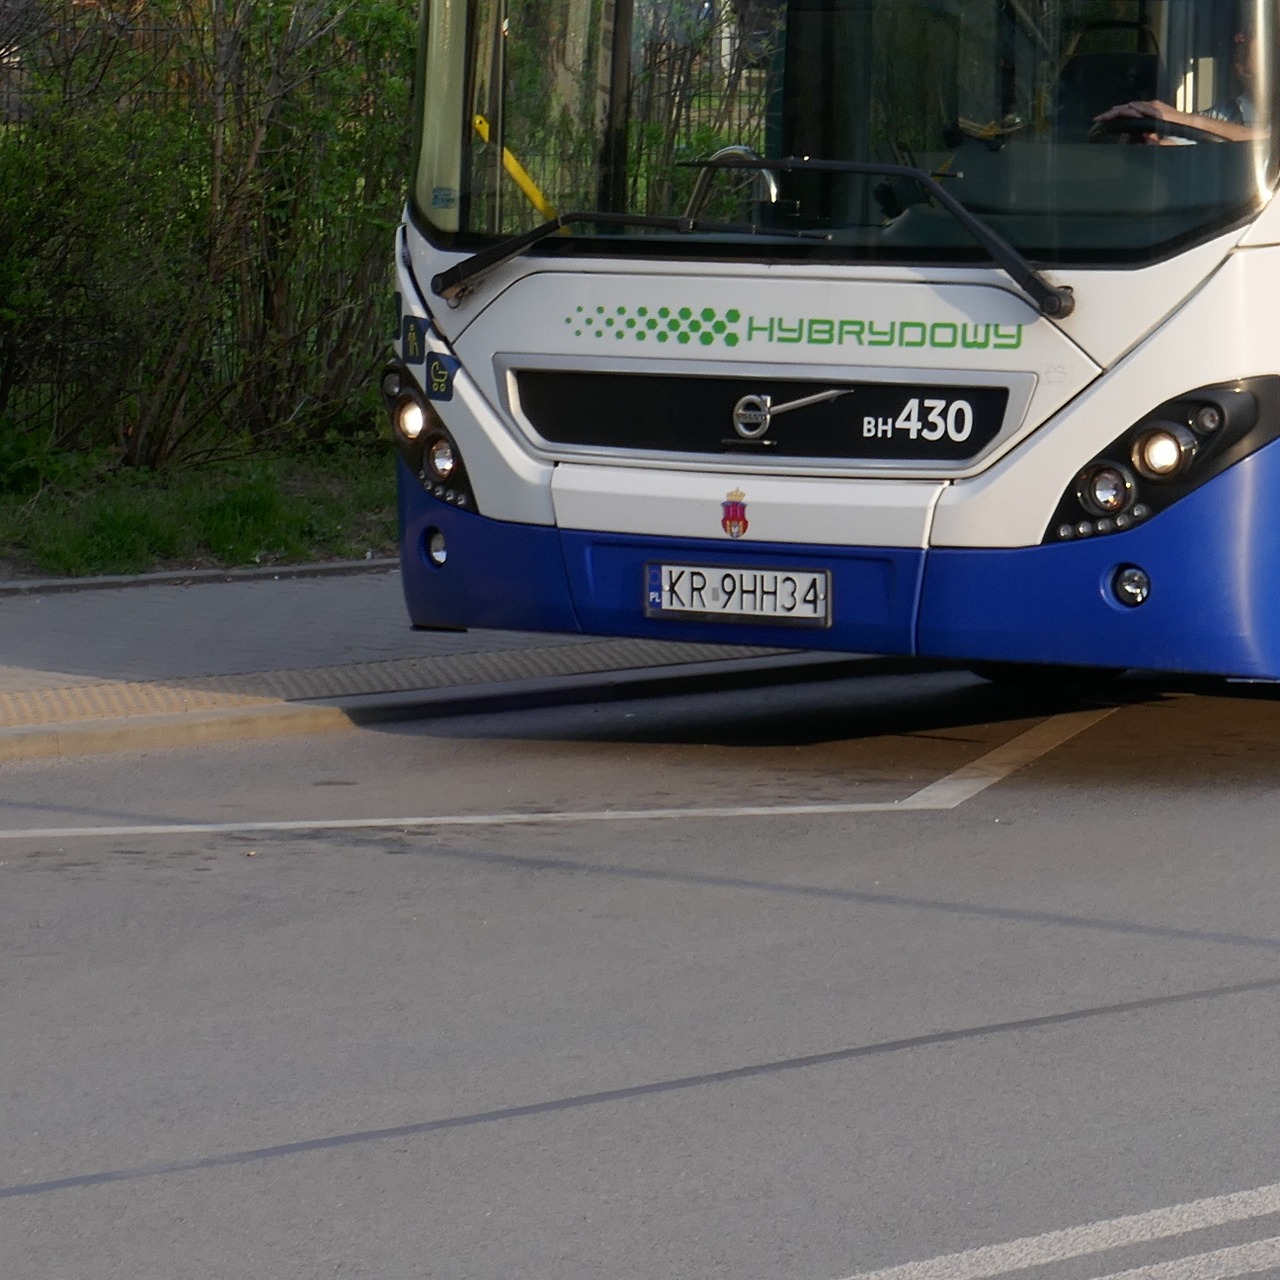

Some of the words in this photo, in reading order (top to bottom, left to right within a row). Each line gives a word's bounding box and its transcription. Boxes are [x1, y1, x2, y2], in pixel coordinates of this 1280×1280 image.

[746, 316, 1023, 350] HYBRYDOWY
[862, 398, 974, 442] BH430
[649, 591, 661, 603] PL
[668, 570, 707, 608] KR
[720, 572, 819, 614] 9HH34
